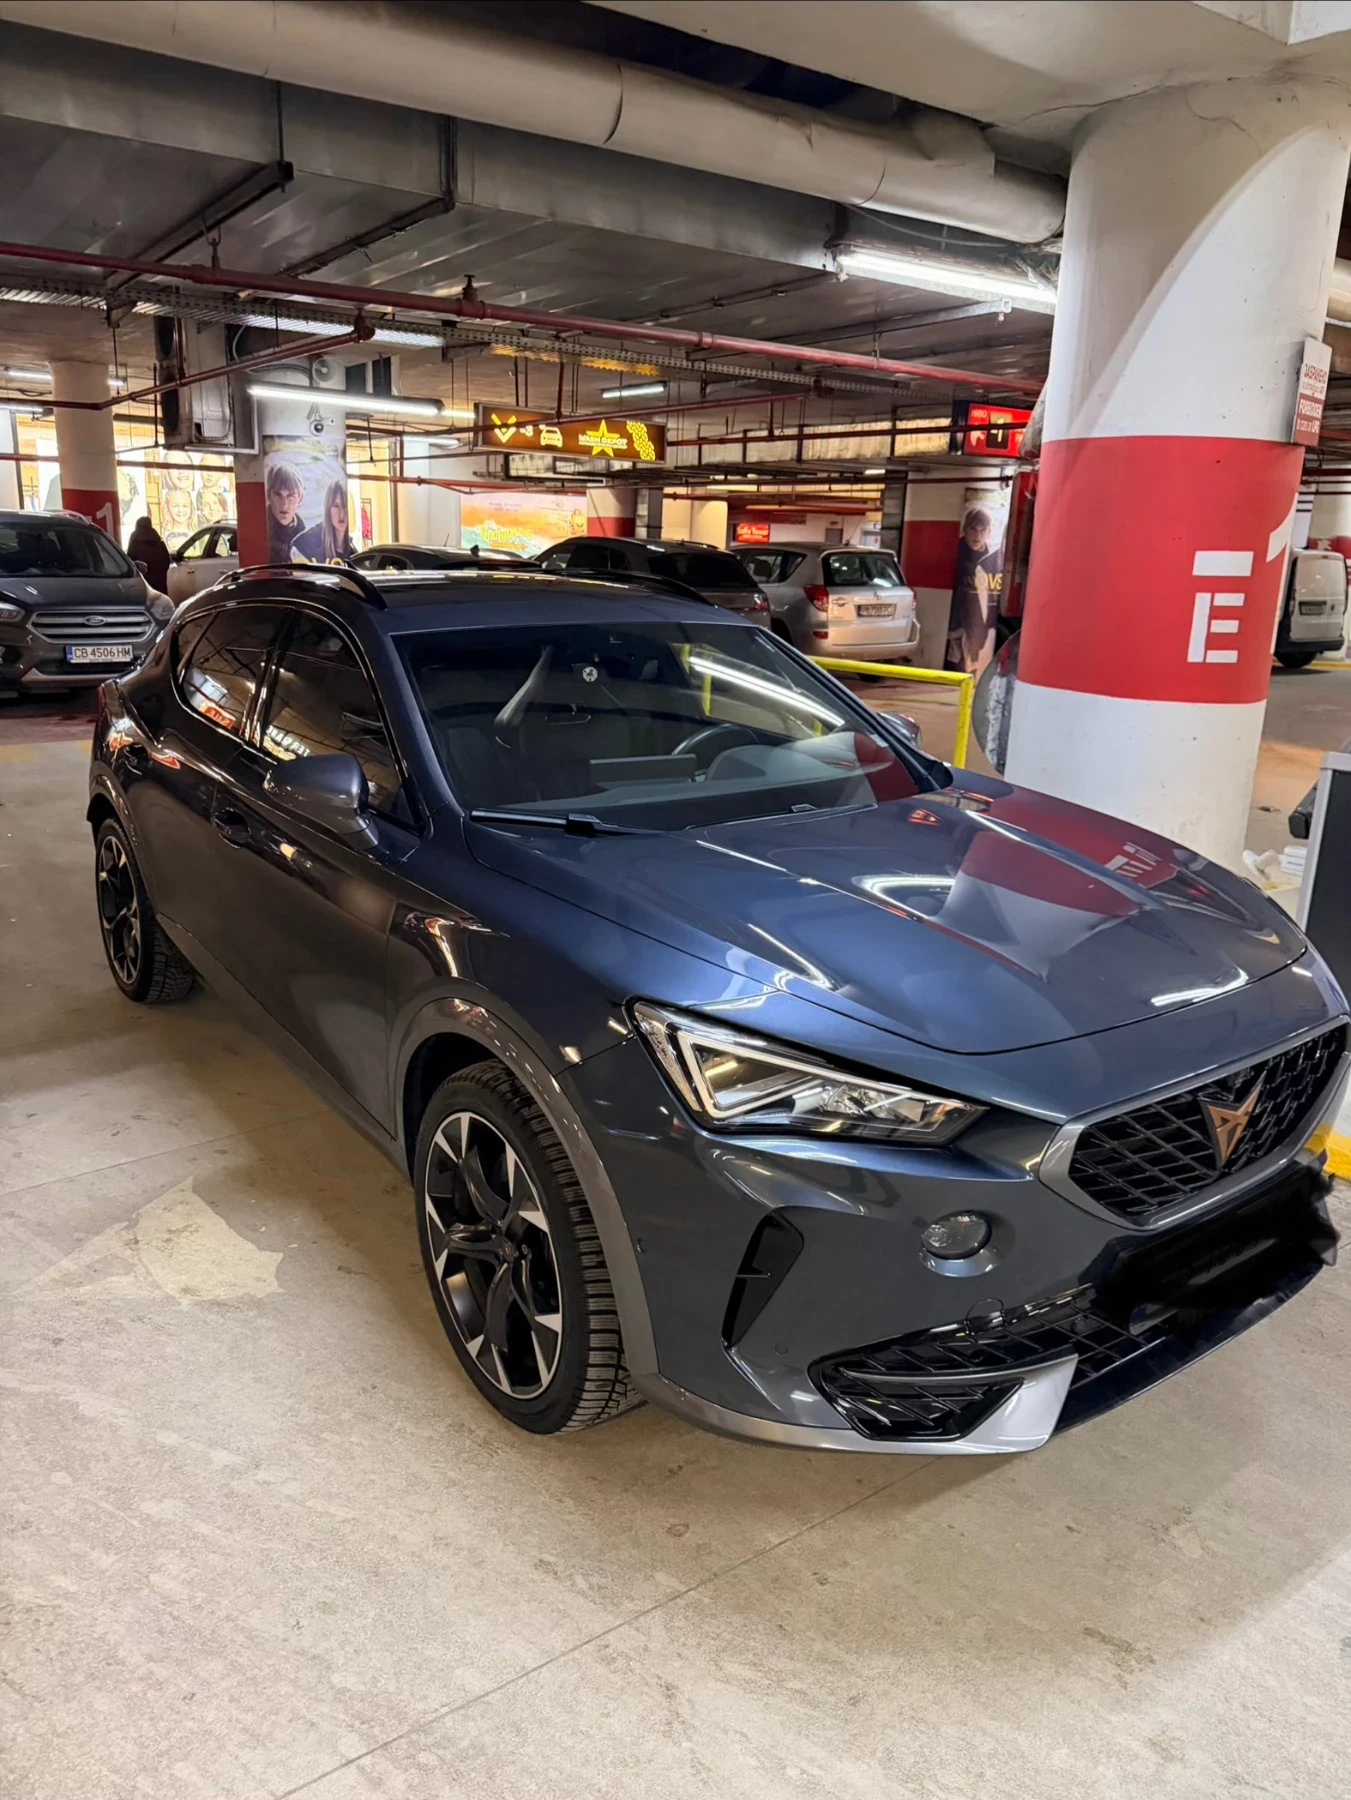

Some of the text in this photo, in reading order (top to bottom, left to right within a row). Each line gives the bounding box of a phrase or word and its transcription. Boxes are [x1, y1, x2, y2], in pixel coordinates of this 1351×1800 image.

[602, 437, 628, 447] DEPOT
[975, 573, 1003, 590] OVS
[1187, 592, 1245, 663] E
[74, 647, 130, 658] CB 4506 HM
